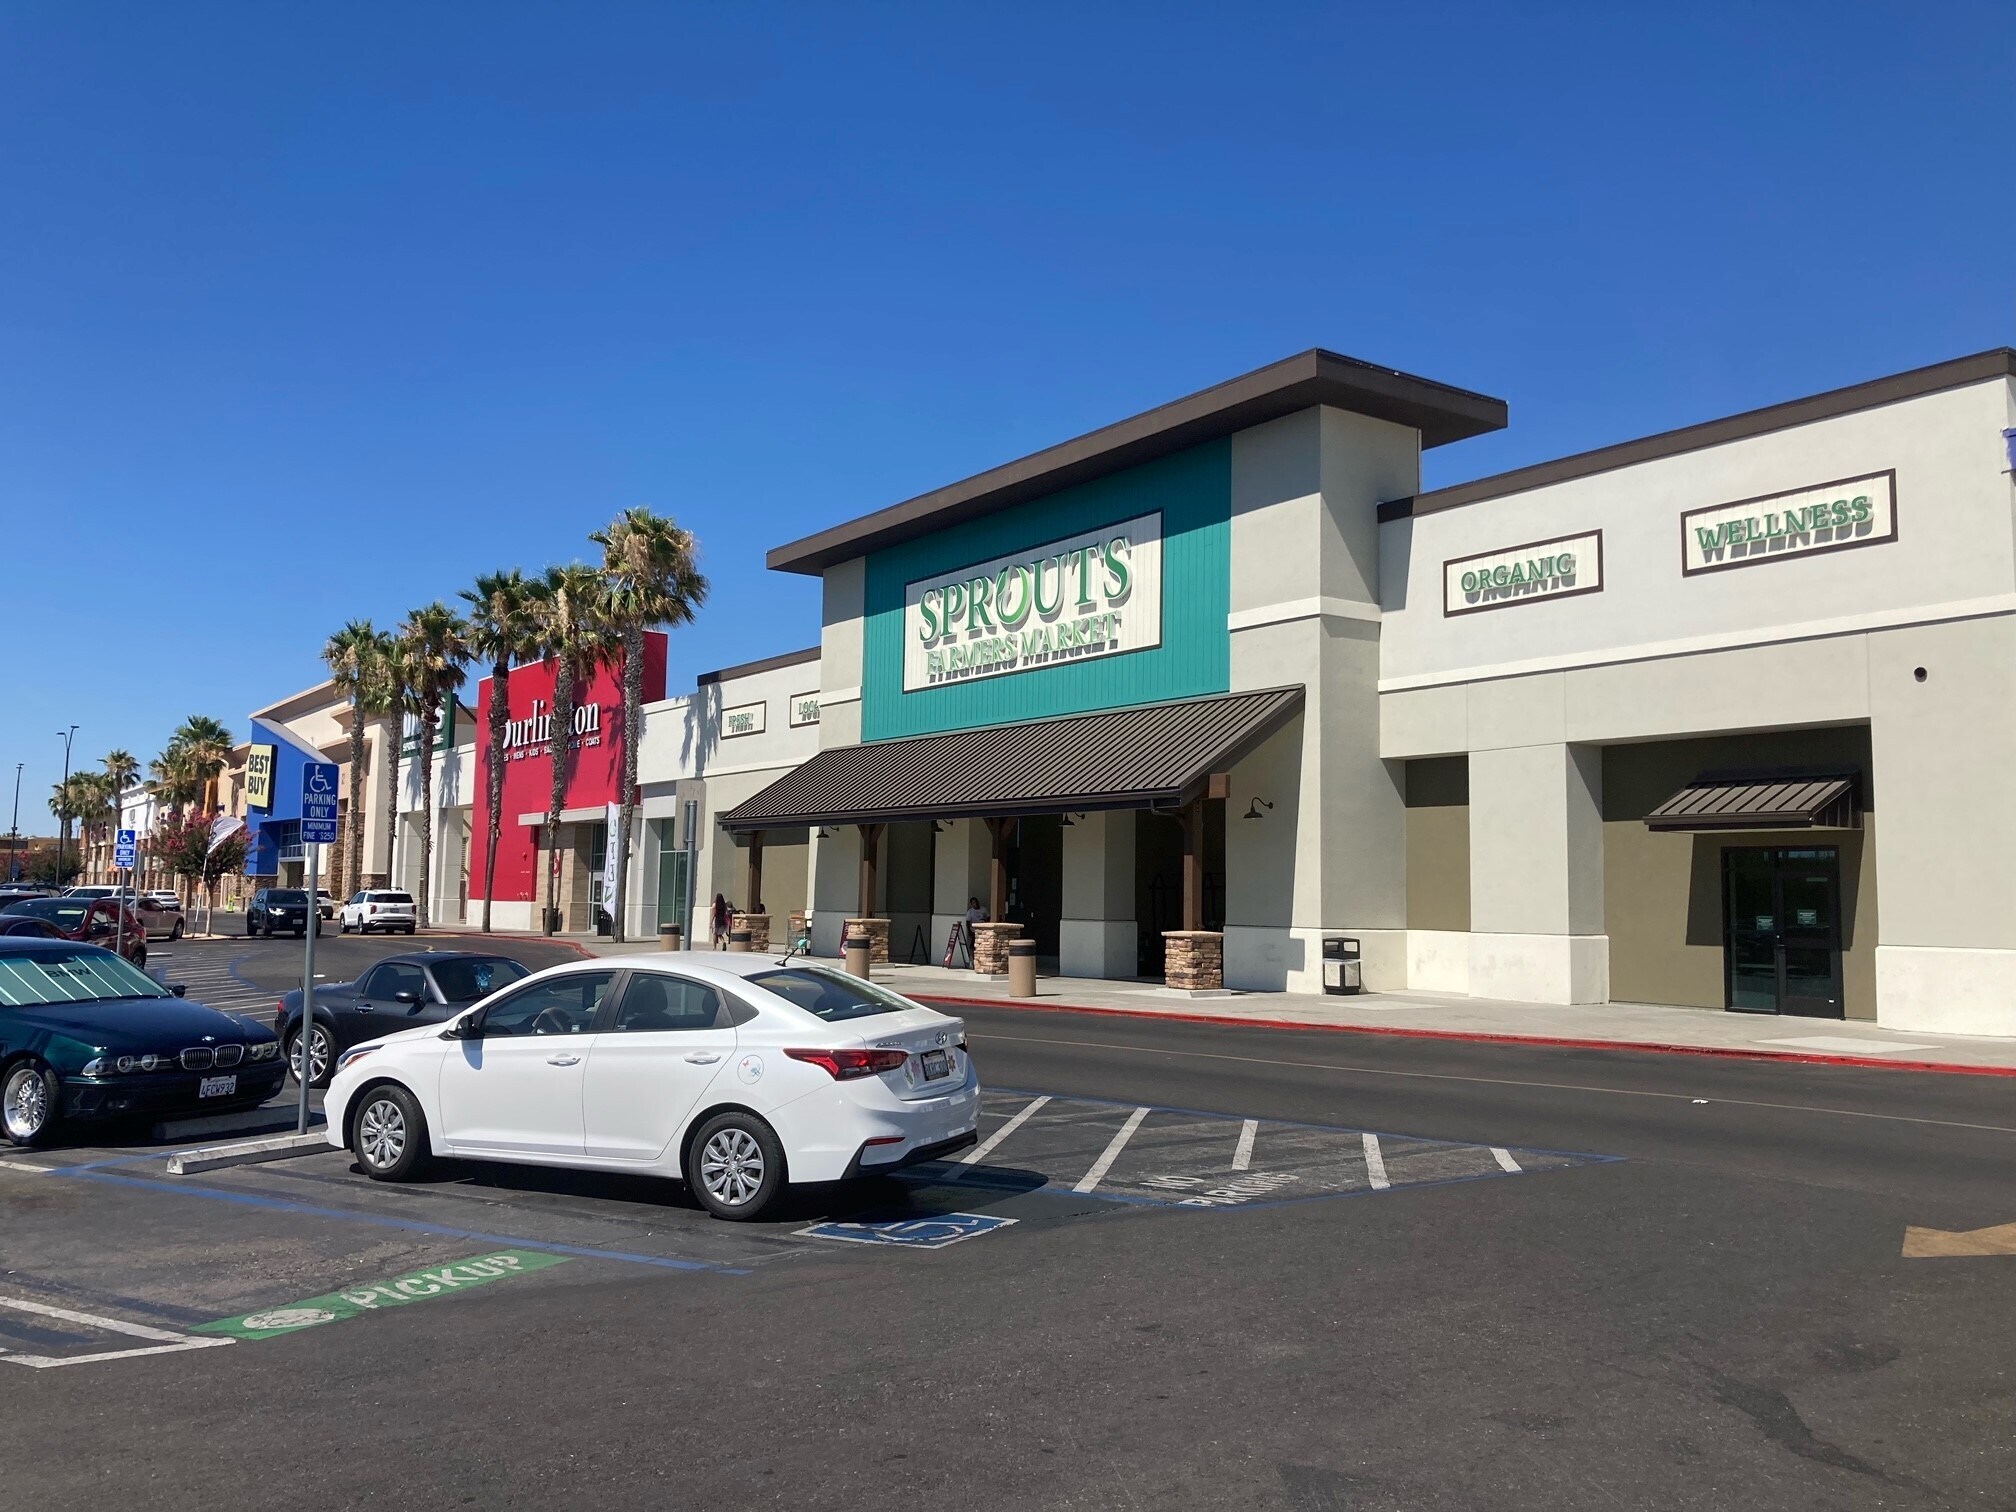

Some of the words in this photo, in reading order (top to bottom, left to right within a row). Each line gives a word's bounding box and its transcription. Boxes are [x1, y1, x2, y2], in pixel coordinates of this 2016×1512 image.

[1695, 495, 1873, 549] WELLNESS
[1461, 552, 1574, 592] ORGANIC
[919, 536, 1133, 643] SPROUTS
[926, 632, 1018, 676] FARMERS
[1020, 611, 1121, 658] MARKET
[798, 699, 819, 716] LOCA
[502, 699, 599, 748] urlinton
[248, 754, 270, 774] BEST
[247, 776, 267, 796] BUY
[304, 793, 336, 806] PARKING
[310, 806, 330, 818] ONLY
[303, 831, 316, 840] FINE
[319, 831, 335, 841] $250
[307, 822, 332, 830] MINIMUM
[45, 968, 91, 978] BMW
[340, 1255, 525, 1309] PICKUP
